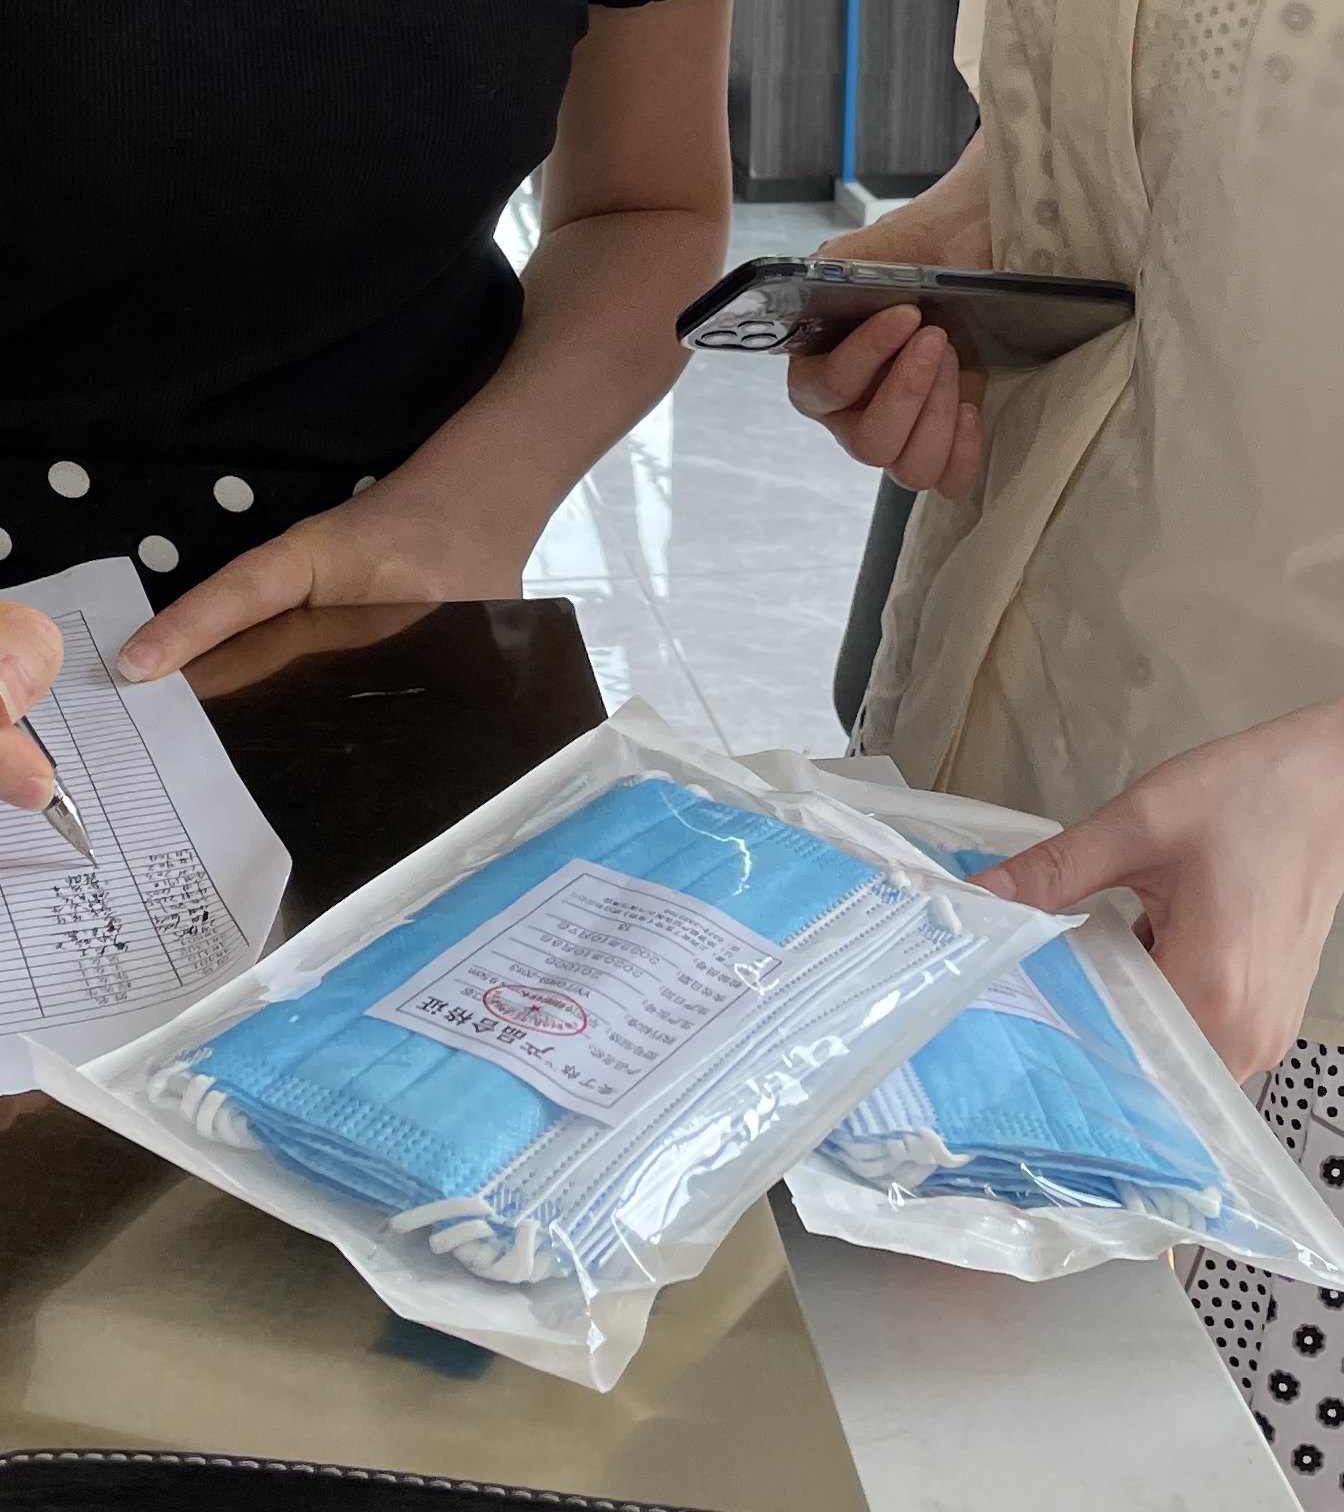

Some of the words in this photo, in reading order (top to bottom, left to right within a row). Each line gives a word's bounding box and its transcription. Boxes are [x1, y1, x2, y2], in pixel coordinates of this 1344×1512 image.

[417, 995, 556, 1059] 产品合格证
